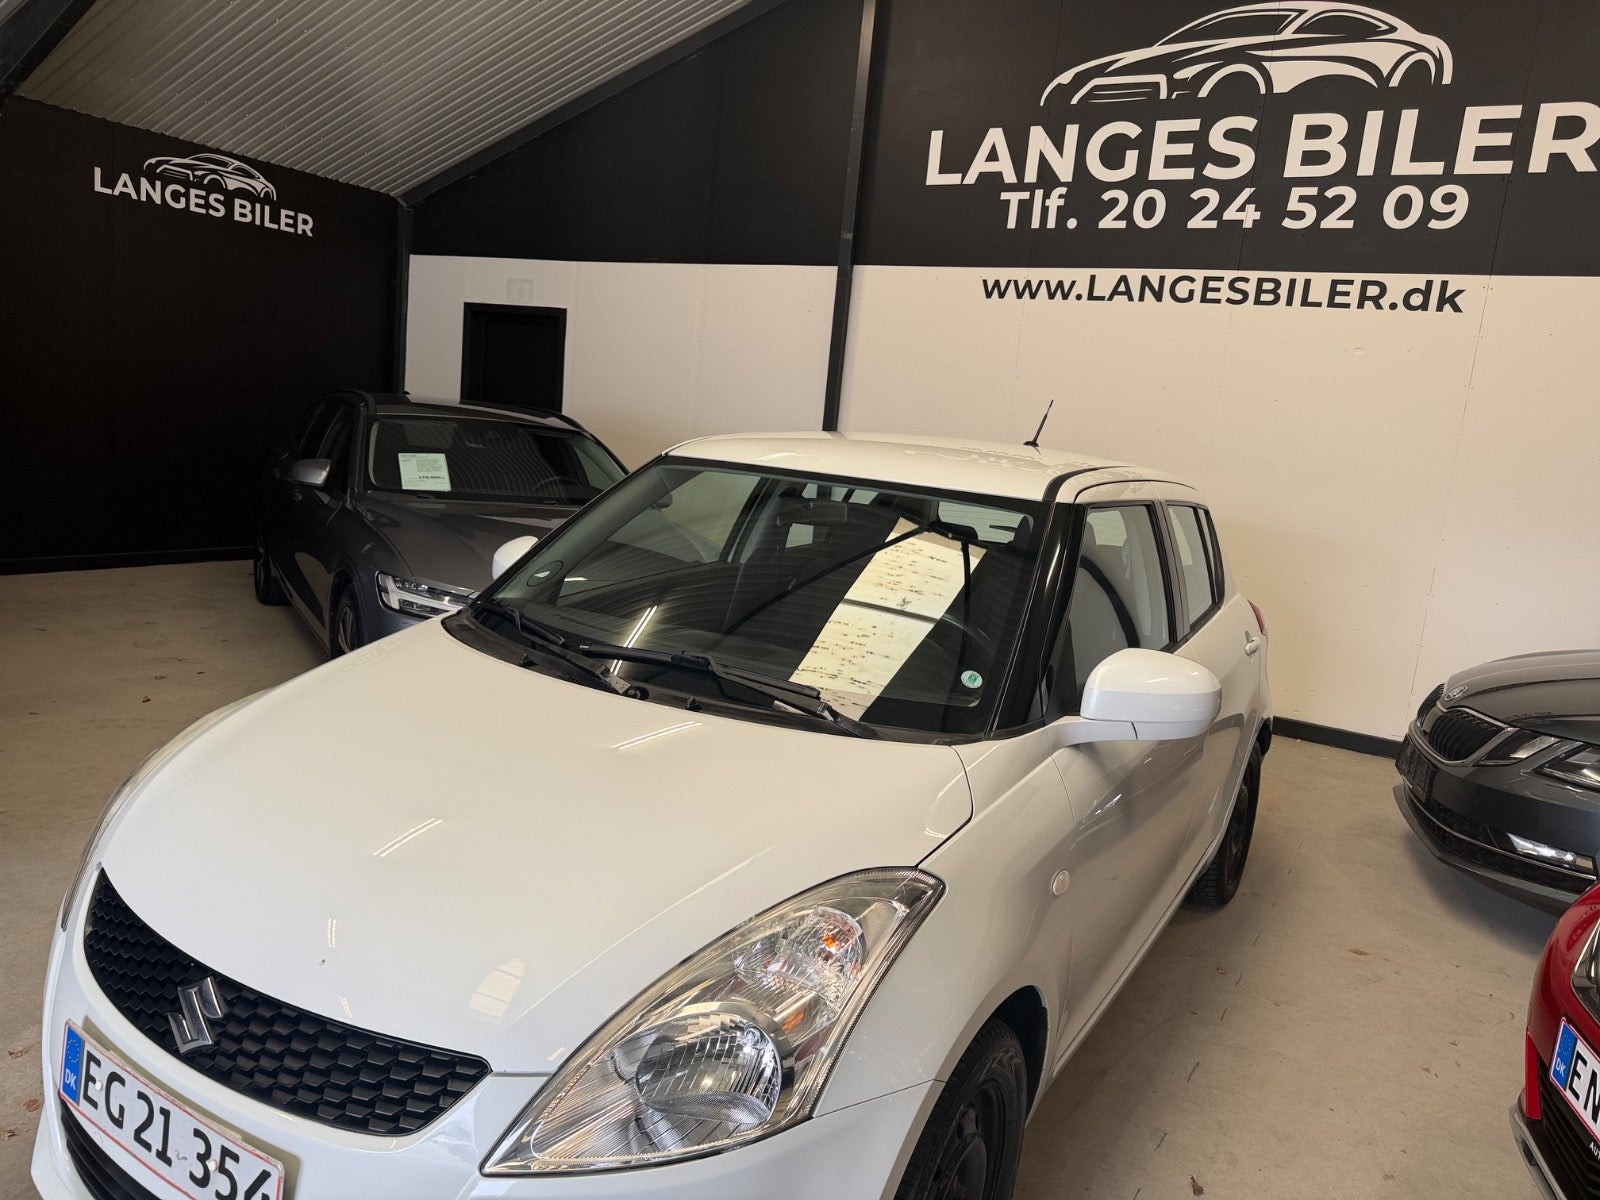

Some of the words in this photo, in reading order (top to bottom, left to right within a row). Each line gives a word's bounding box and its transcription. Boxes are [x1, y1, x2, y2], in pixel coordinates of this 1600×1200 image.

[925, 115, 1259, 186] LANGES
[1283, 101, 1600, 178] BILER
[94, 166, 226, 218] LANGES
[233, 198, 314, 237] BILER
[1000, 186, 1078, 229] Tlf.
[1098, 188, 1167, 229] 20
[1186, 187, 1261, 229] 24
[1281, 185, 1357, 230] 52
[1382, 184, 1470, 230] 09
[981, 274, 1467, 314] www.LANGESBILER.dk
[64, 1068, 77, 1091] DK
[1555, 1056, 1567, 1078] DK
[82, 1049, 126, 1130] EG
[133, 1090, 173, 1168] 21
